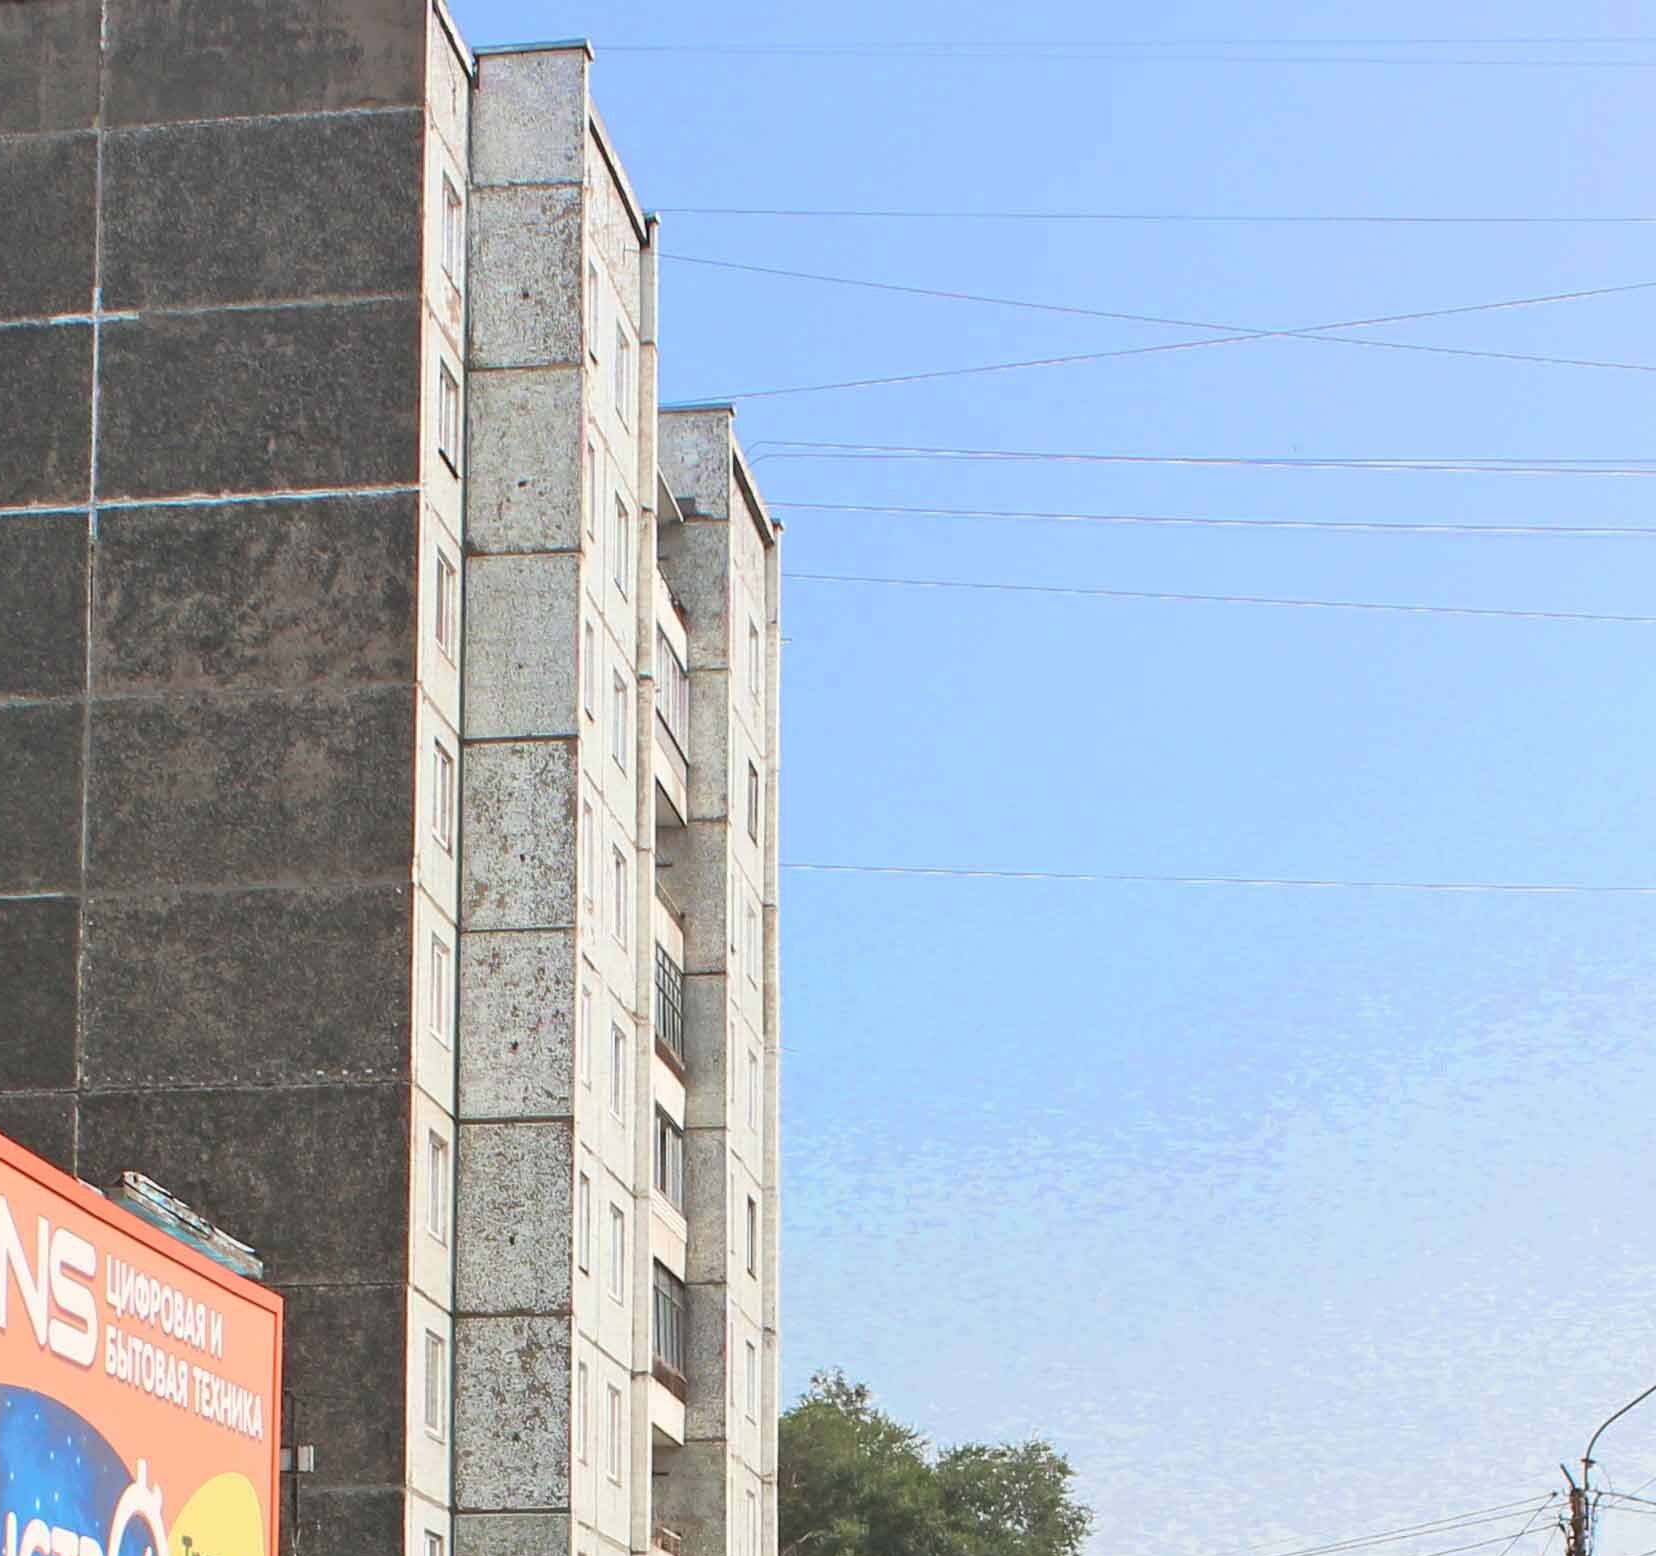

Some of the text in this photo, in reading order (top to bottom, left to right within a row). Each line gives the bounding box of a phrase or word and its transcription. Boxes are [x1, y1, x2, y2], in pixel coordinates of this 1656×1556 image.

[104, 1254, 225, 1358] ЦИФРОВАЯ И
[103, 1323, 264, 1441] БЫТОВАЯ ТЕХНИКА
